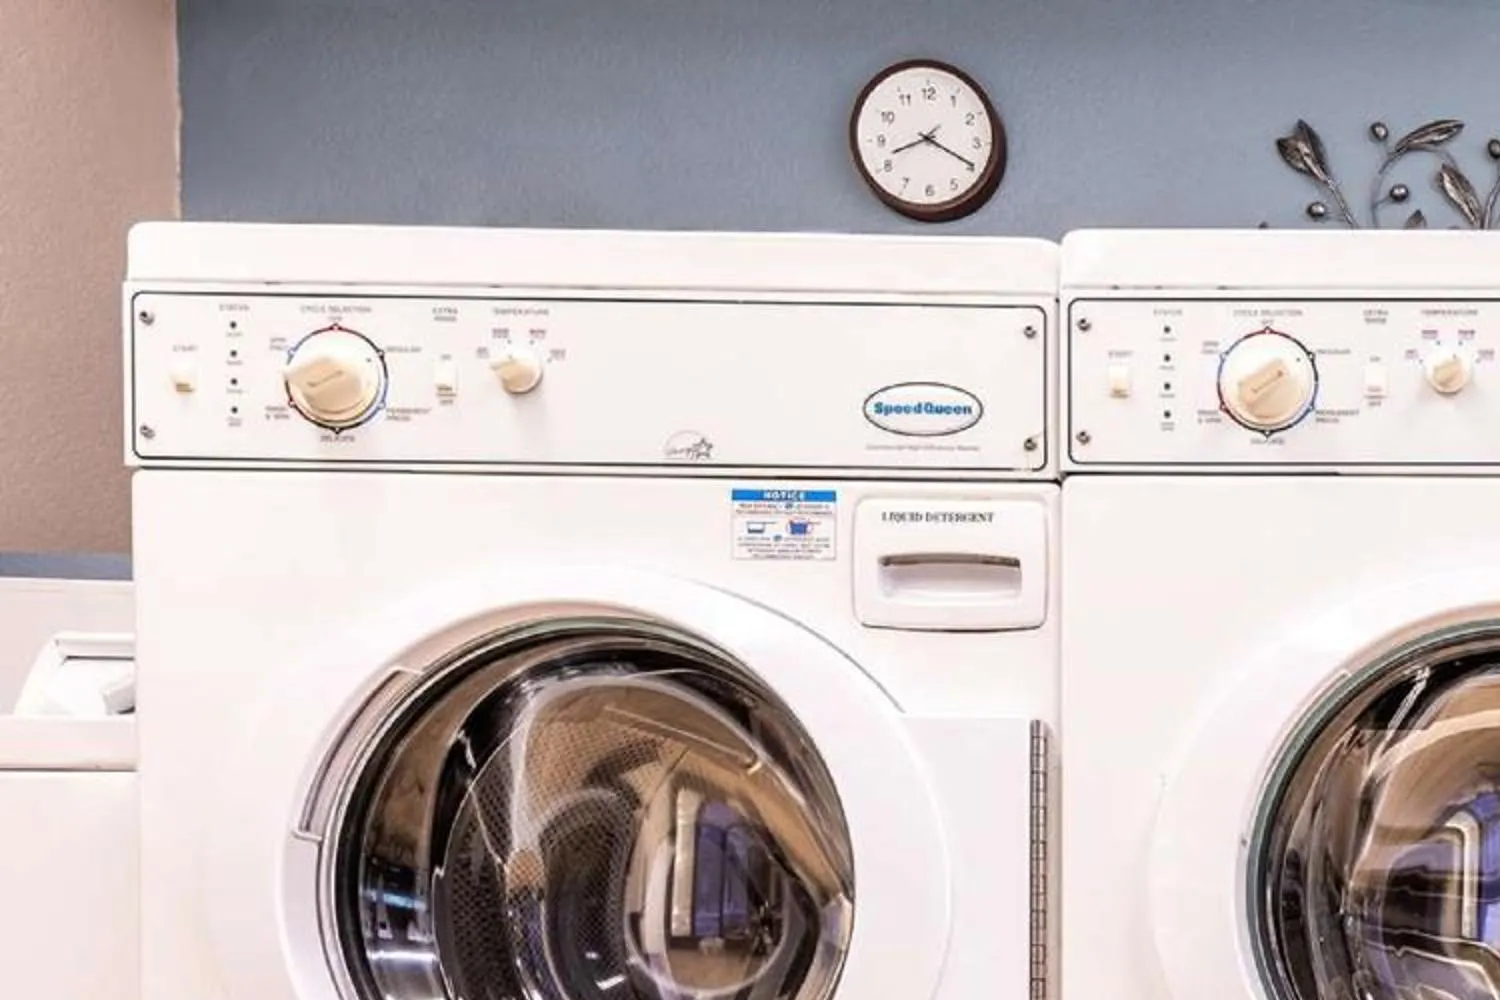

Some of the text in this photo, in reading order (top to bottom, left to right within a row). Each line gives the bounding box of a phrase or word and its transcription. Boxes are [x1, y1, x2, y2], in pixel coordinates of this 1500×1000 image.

[899, 95, 911, 105] 11
[922, 88, 937, 101] 12
[950, 96, 956, 107] 1
[881, 112, 894, 124] 10
[965, 113, 975, 125] 2
[877, 135, 886, 146] 9
[973, 137, 981, 149] 3
[884, 160, 892, 172] 8
[903, 177, 910, 189] 7
[950, 179, 958, 190] 5
[925, 185, 934, 196] 6
[881, 511, 994, 524] LIQUID DETERGENT
